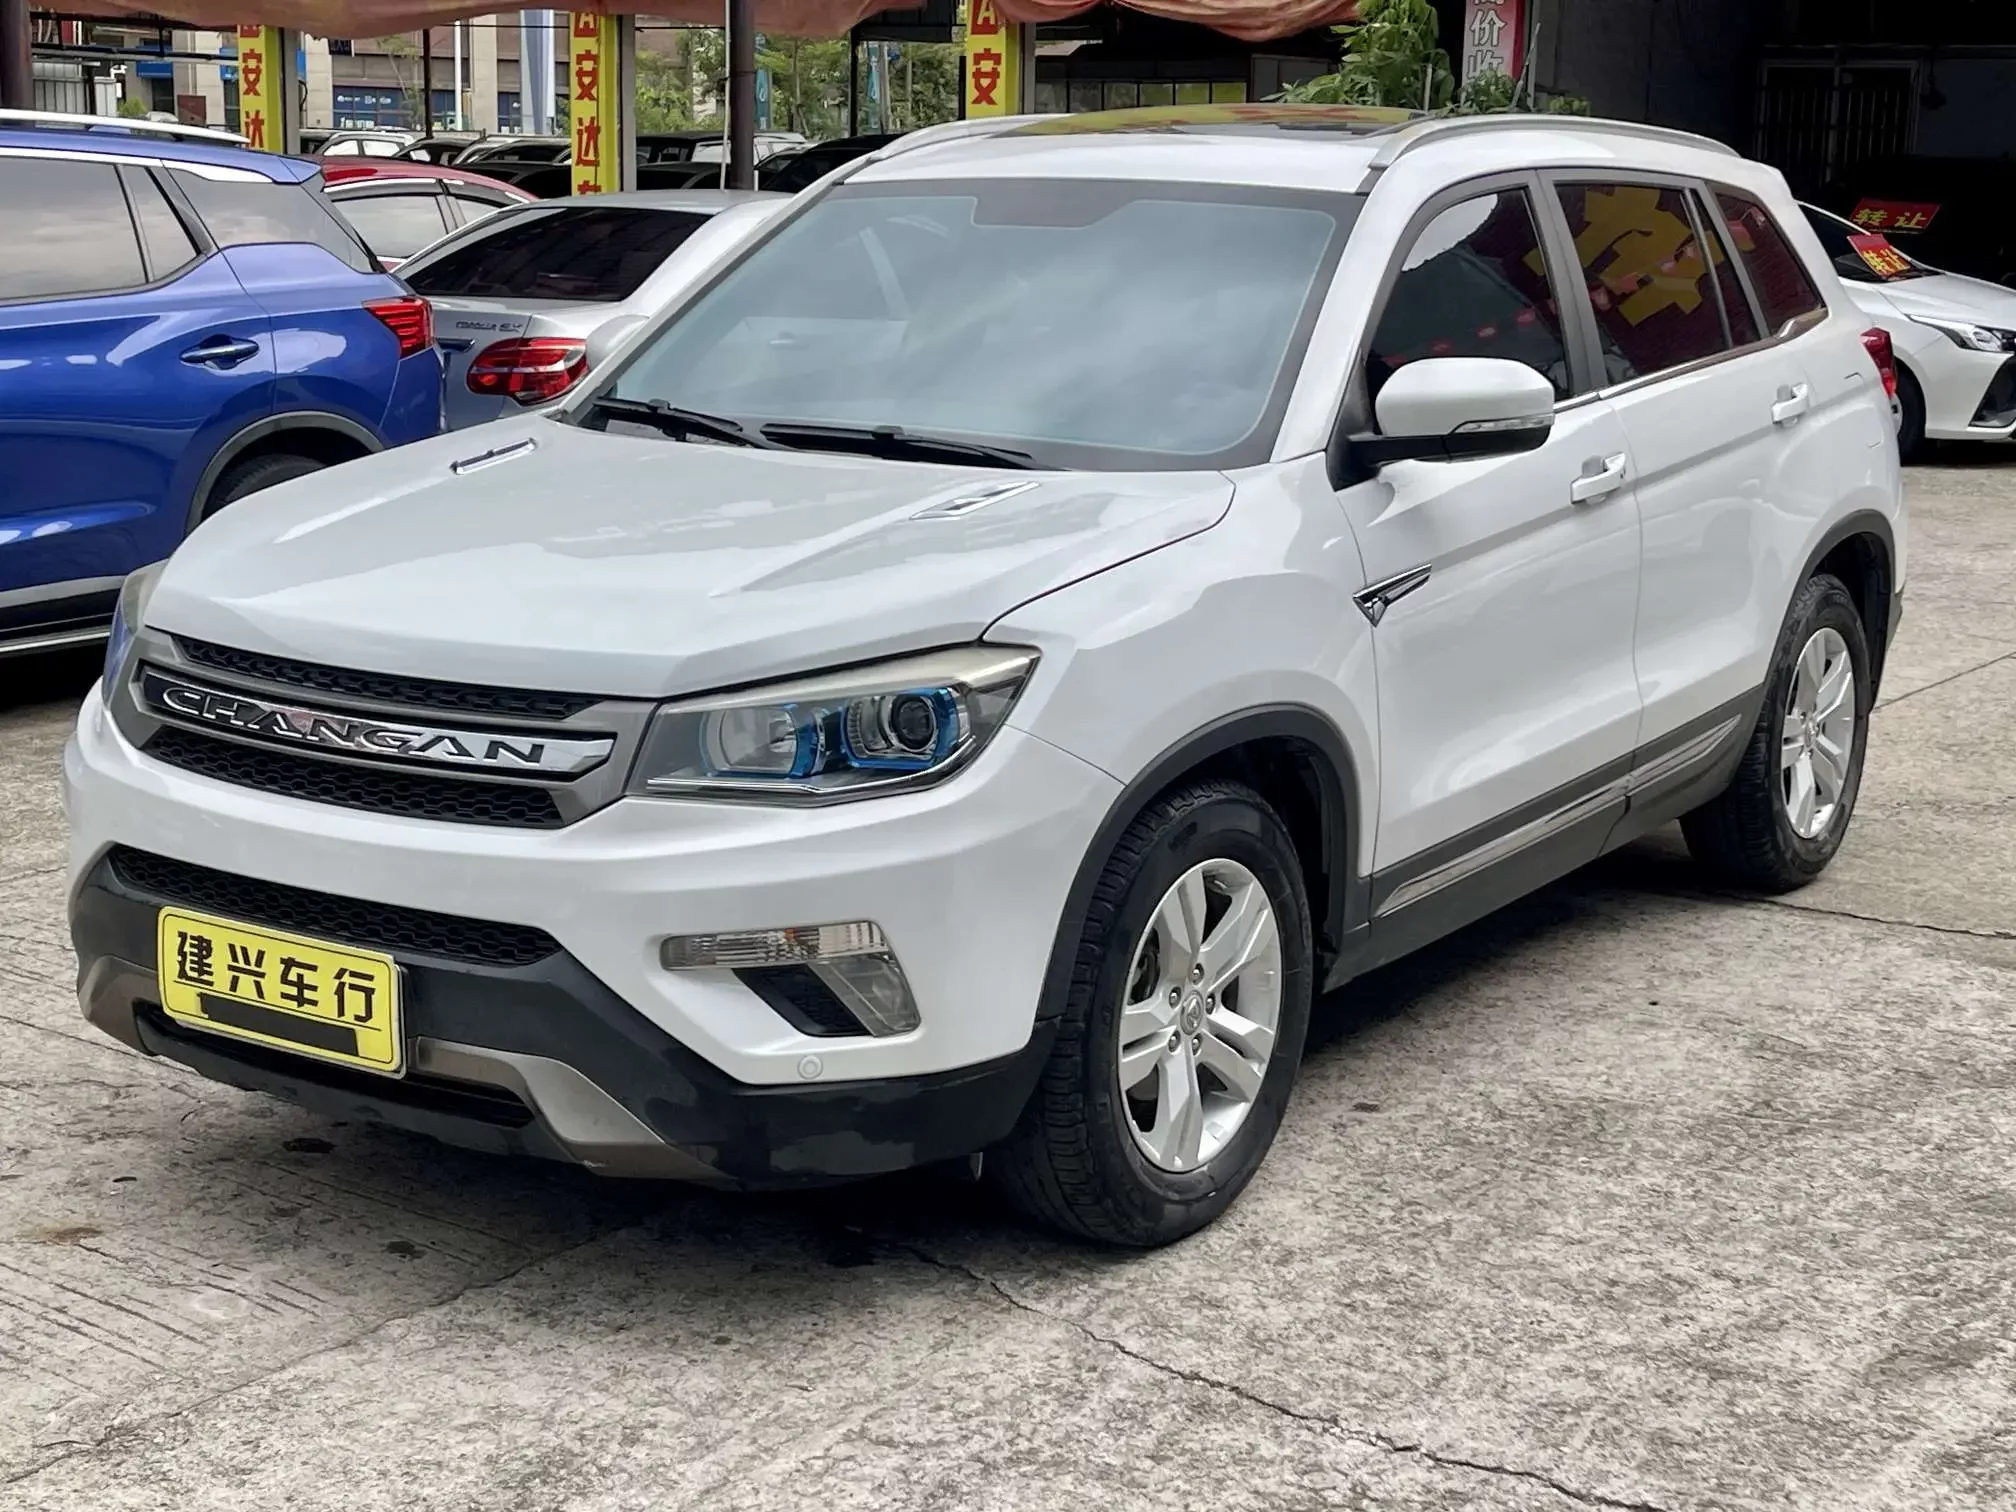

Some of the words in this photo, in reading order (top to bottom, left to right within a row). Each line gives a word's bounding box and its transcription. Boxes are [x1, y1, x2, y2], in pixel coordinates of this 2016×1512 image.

[1467, 0, 1507, 79] 价收
[240, 25, 264, 148] 安达
[1853, 208, 1928, 229] 转让
[161, 686, 545, 766] CHANGAN
[176, 930, 377, 1024] 建兴车行
